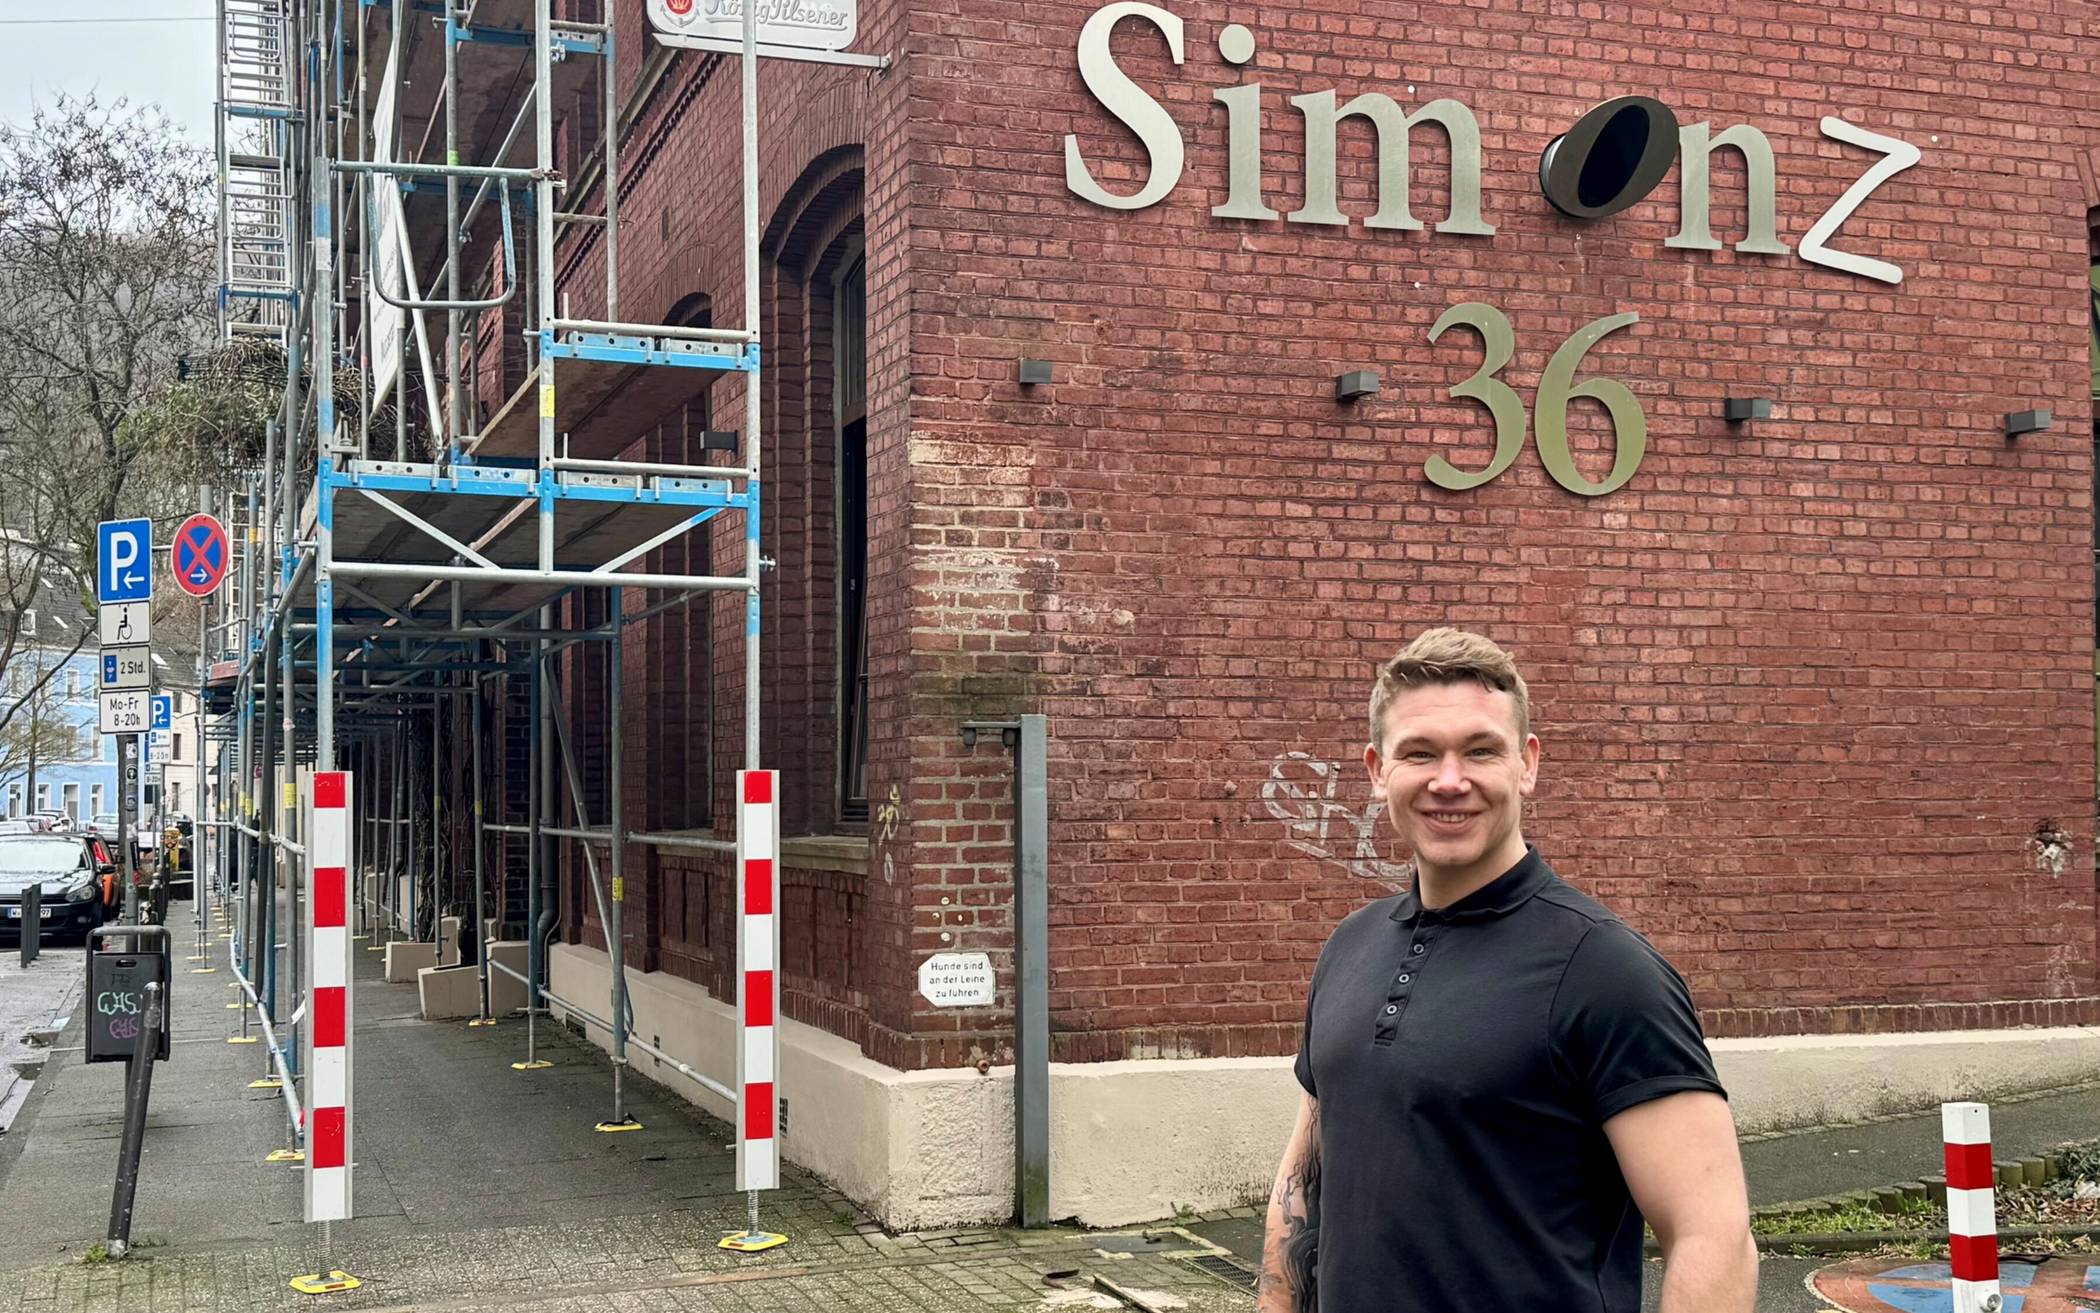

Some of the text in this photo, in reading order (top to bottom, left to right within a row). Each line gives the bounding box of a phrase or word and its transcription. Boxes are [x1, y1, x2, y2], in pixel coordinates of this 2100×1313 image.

[1065, 1, 1922, 284] Simonz
[1424, 302, 1647, 496] 36
[110, 531, 138, 592] P
[120, 660, 146, 675] 2 Std.
[109, 697, 140, 711] Mo-Fr
[113, 713, 141, 727] 8-20h
[152, 700, 165, 725] P
[931, 961, 983, 971] Hunde sind
[943, 975, 958, 984] der
[960, 975, 985, 984] Leine
